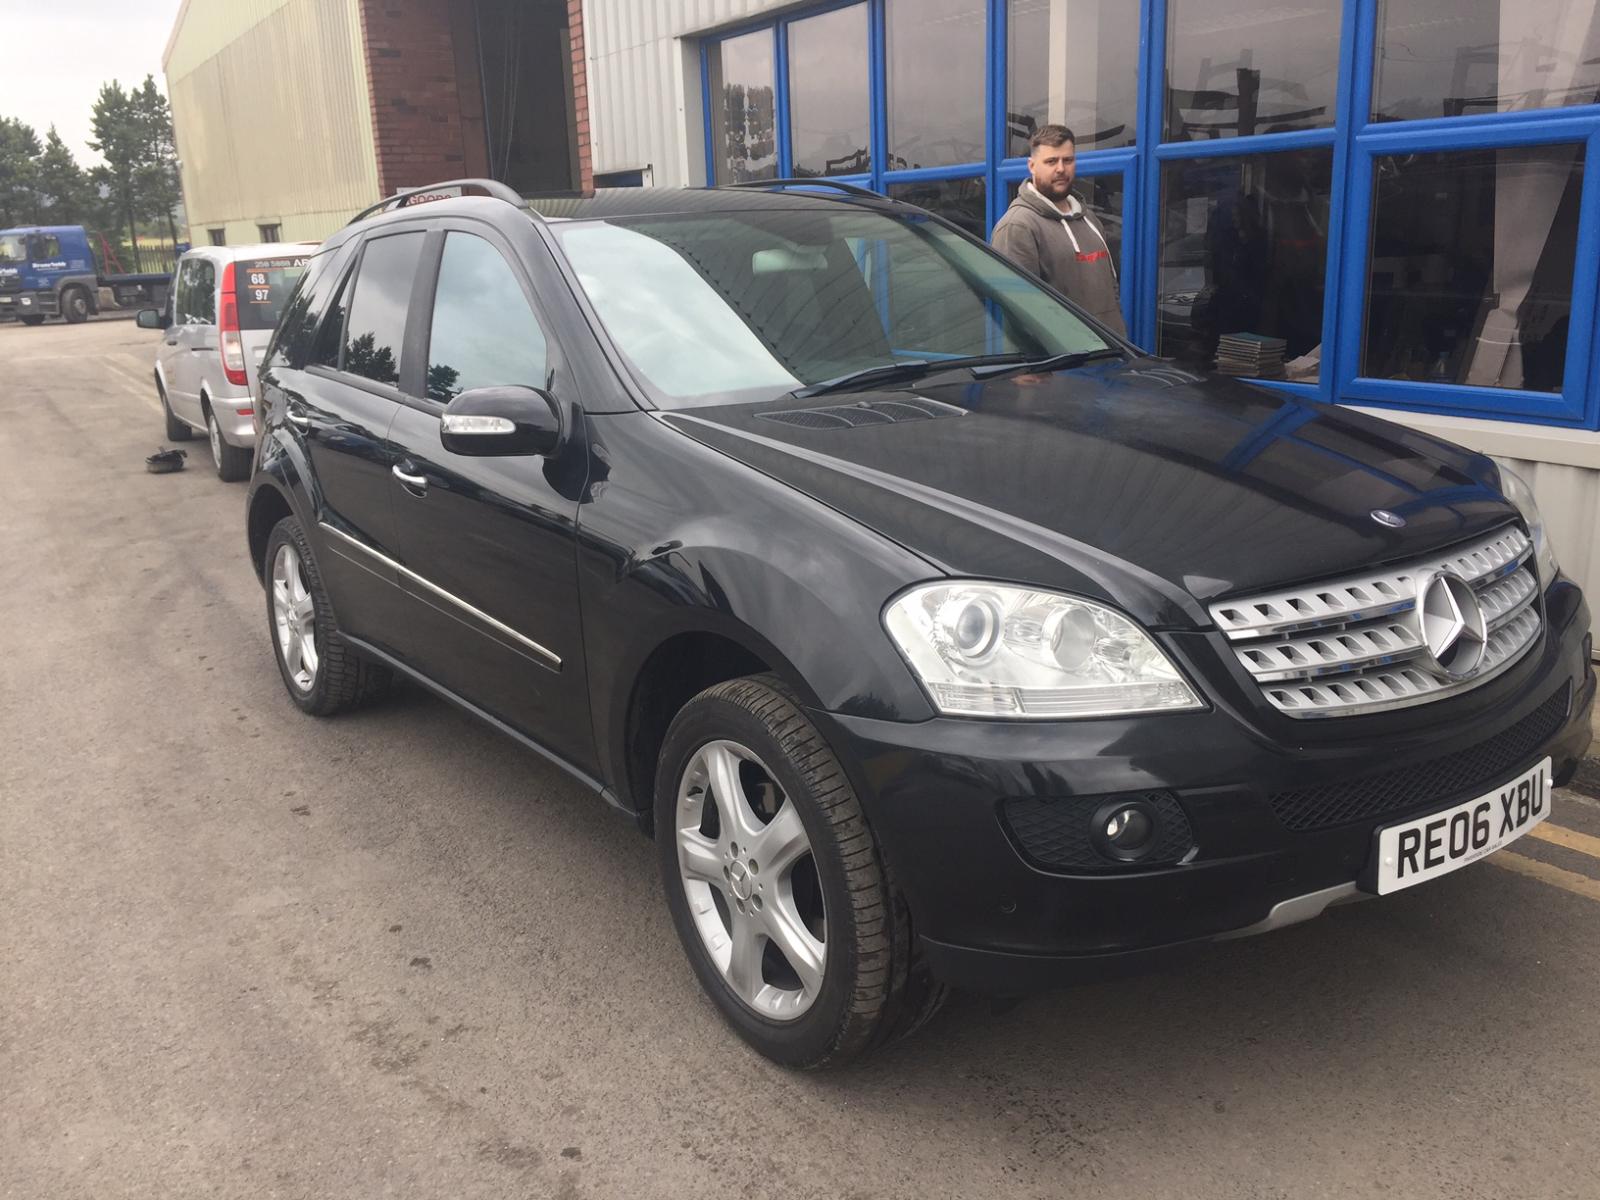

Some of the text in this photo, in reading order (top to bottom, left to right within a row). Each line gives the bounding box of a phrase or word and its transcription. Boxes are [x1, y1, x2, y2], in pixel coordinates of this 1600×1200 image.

[251, 273, 266, 285] 68
[255, 289, 269, 300] 97
[1397, 768, 1544, 879] RE06 XBU
